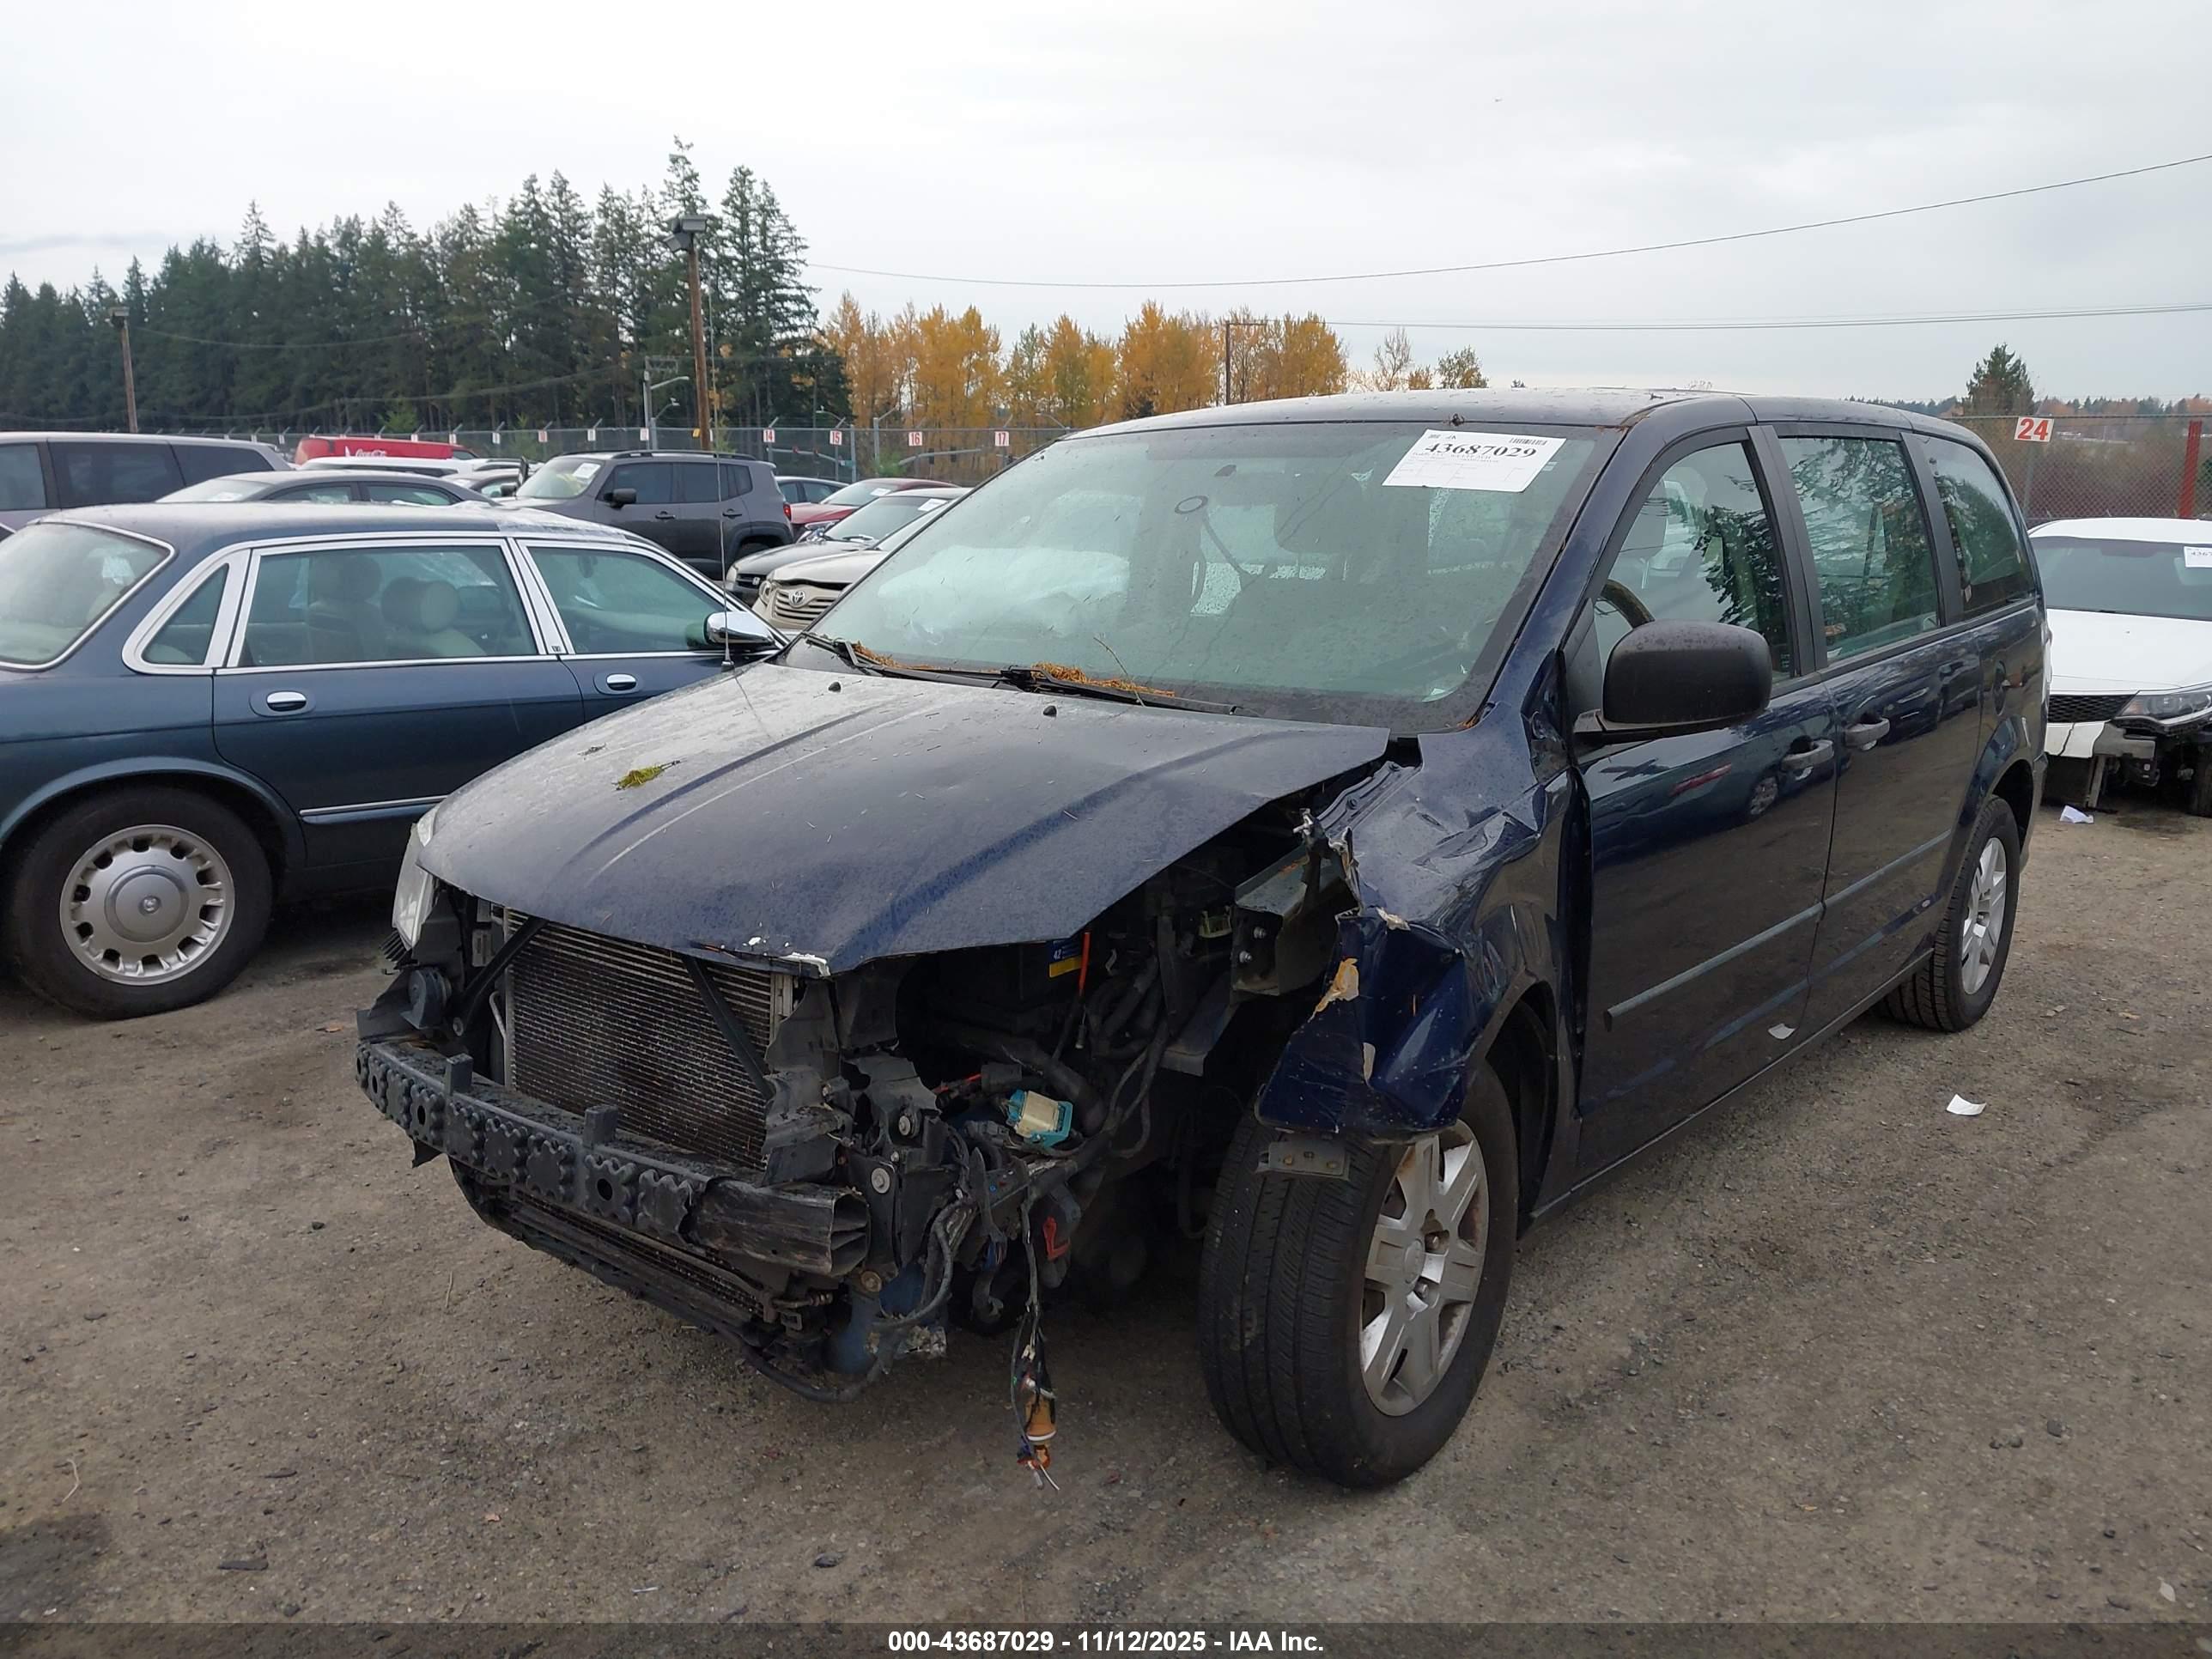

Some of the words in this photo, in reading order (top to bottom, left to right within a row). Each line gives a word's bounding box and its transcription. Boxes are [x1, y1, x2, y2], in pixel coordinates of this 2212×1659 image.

[764, 430, 774, 441] 14
[2018, 418, 2049, 441] 24
[831, 431, 841, 444] 15
[911, 432, 921, 445] 16
[998, 432, 1007, 445] 17
[1425, 442, 1537, 459] 43687029
